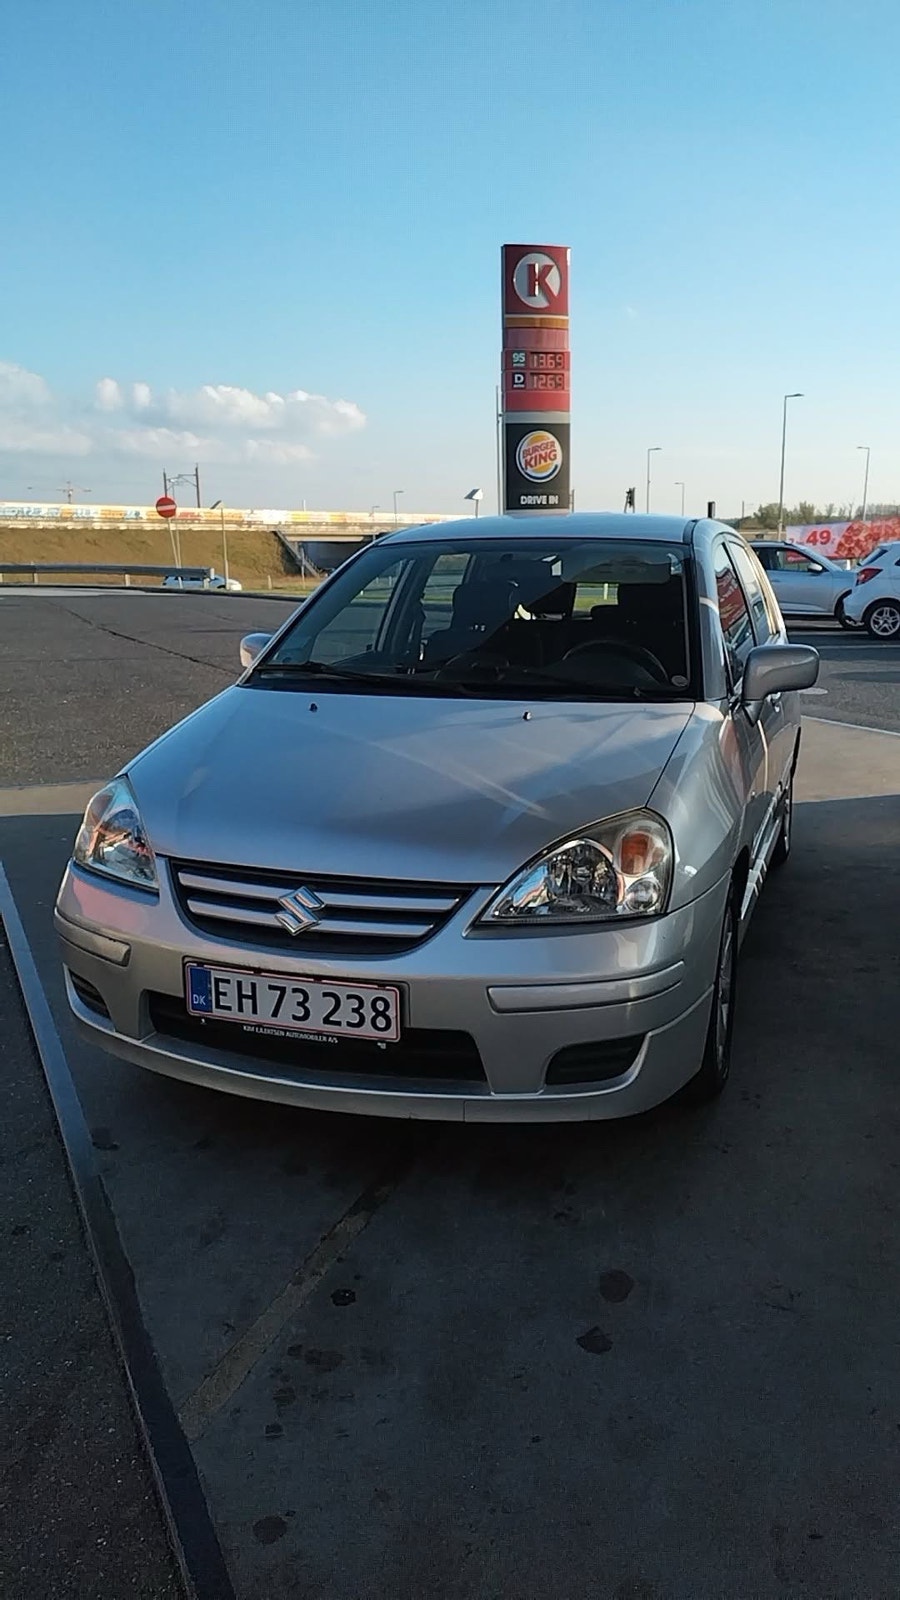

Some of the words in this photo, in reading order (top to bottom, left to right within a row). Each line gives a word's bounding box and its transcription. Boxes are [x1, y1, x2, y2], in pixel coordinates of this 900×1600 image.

[526, 262, 559, 302] K
[512, 352, 526, 363] 95
[514, 374, 525, 384] D
[522, 441, 556, 459] BURGER
[524, 449, 557, 470] KING
[520, 495, 547, 505] DRIVE
[548, 495, 559, 505] IN
[193, 994, 206, 1006] DK
[213, 977, 258, 1015] EH
[267, 984, 311, 1022] 73
[321, 991, 392, 1032] 238
[285, 1031, 327, 1043] AUTOMOBILER
